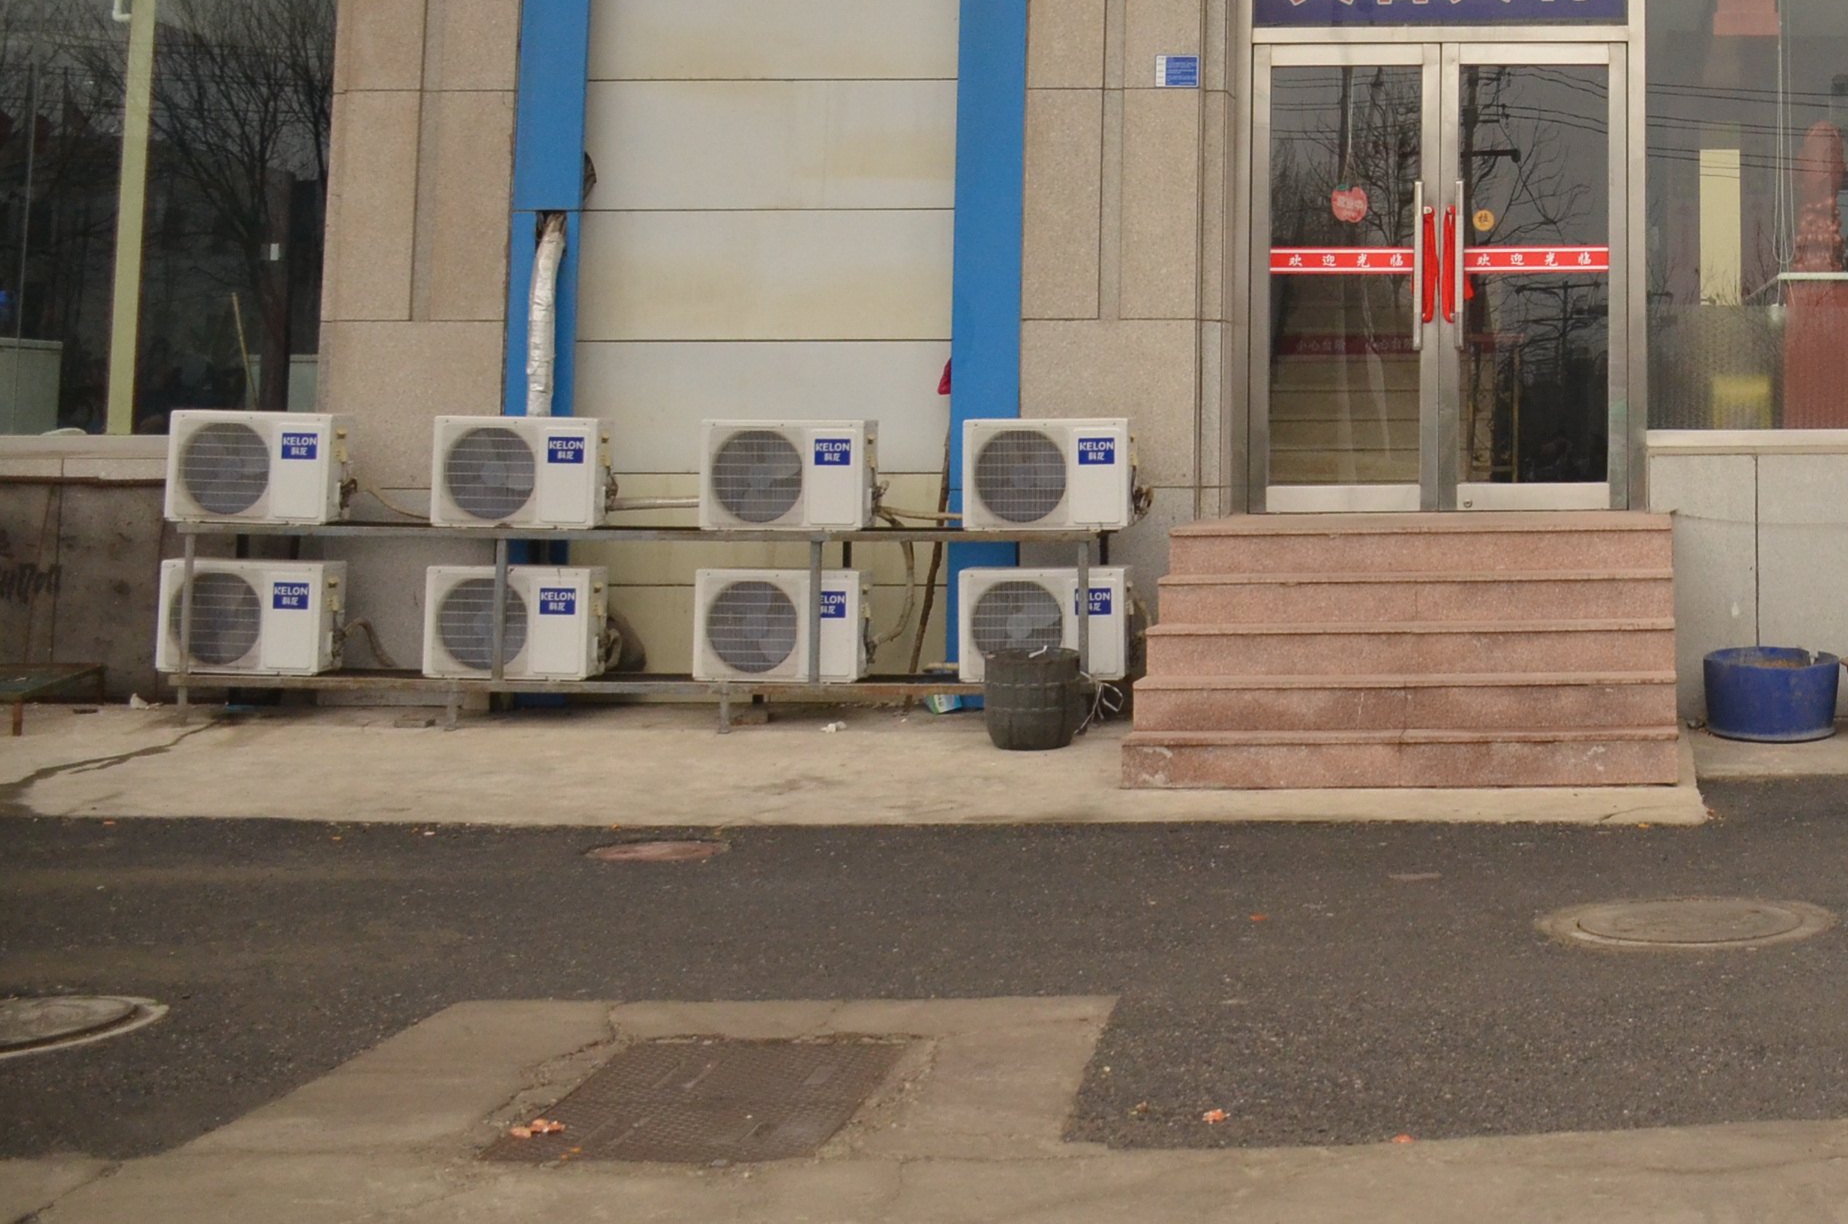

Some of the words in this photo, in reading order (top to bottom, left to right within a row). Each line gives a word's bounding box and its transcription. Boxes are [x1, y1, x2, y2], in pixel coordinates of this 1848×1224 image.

[1289, 254, 1403, 267] 欢迎光临
[1476, 251, 1592, 266] 欢迎光临
[283, 436, 317, 446] KELON
[550, 440, 584, 450] KELON
[1079, 441, 1114, 451] KELON
[815, 442, 850, 452] KELON
[274, 586, 309, 596] KELON
[541, 591, 576, 601] KELON
[1075, 591, 1111, 601] LON
[820, 595, 845, 604] ELON
